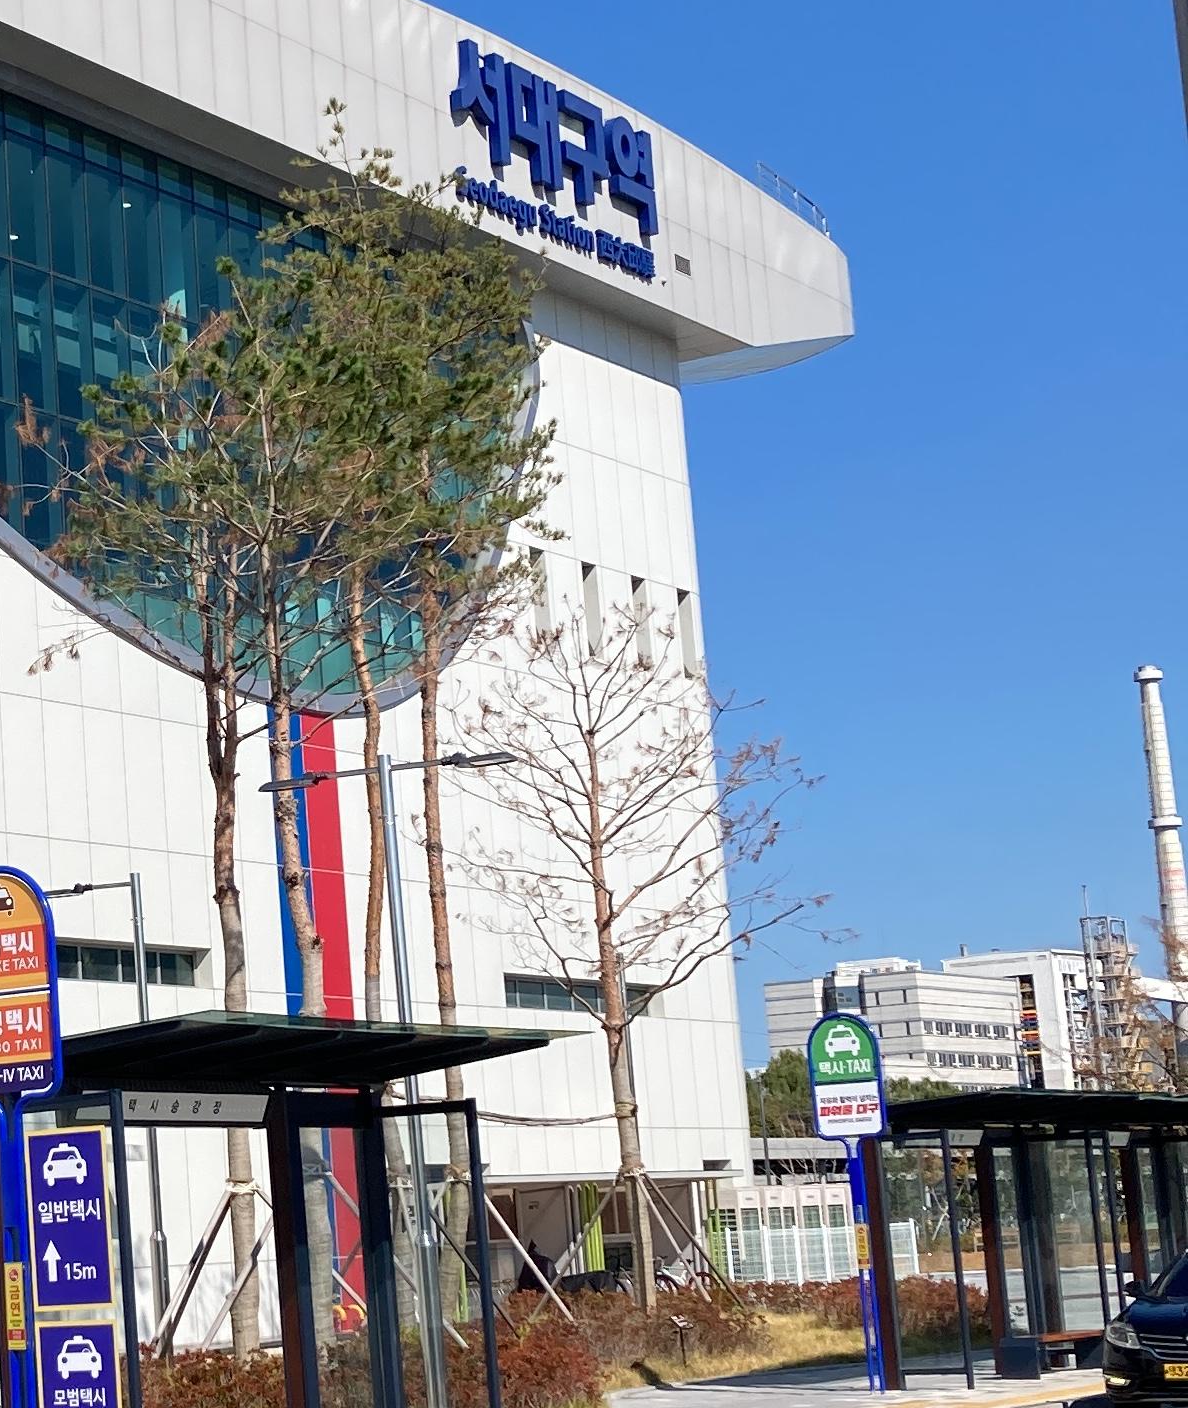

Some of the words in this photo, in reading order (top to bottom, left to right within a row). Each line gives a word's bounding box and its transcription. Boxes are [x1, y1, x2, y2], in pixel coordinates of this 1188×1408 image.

[450, 39, 659, 236] 서대구역
[538, 204, 595, 253] Station
[12, 956, 39, 971] TAXI
[14, 1037, 42, 1051] TAXI
[17, 1065, 44, 1081] TAXI
[38, 1198, 101, 1224] 일반택시
[64, 1262, 97, 1281] 15m
[53, 1387, 106, 1407] 모범택시
